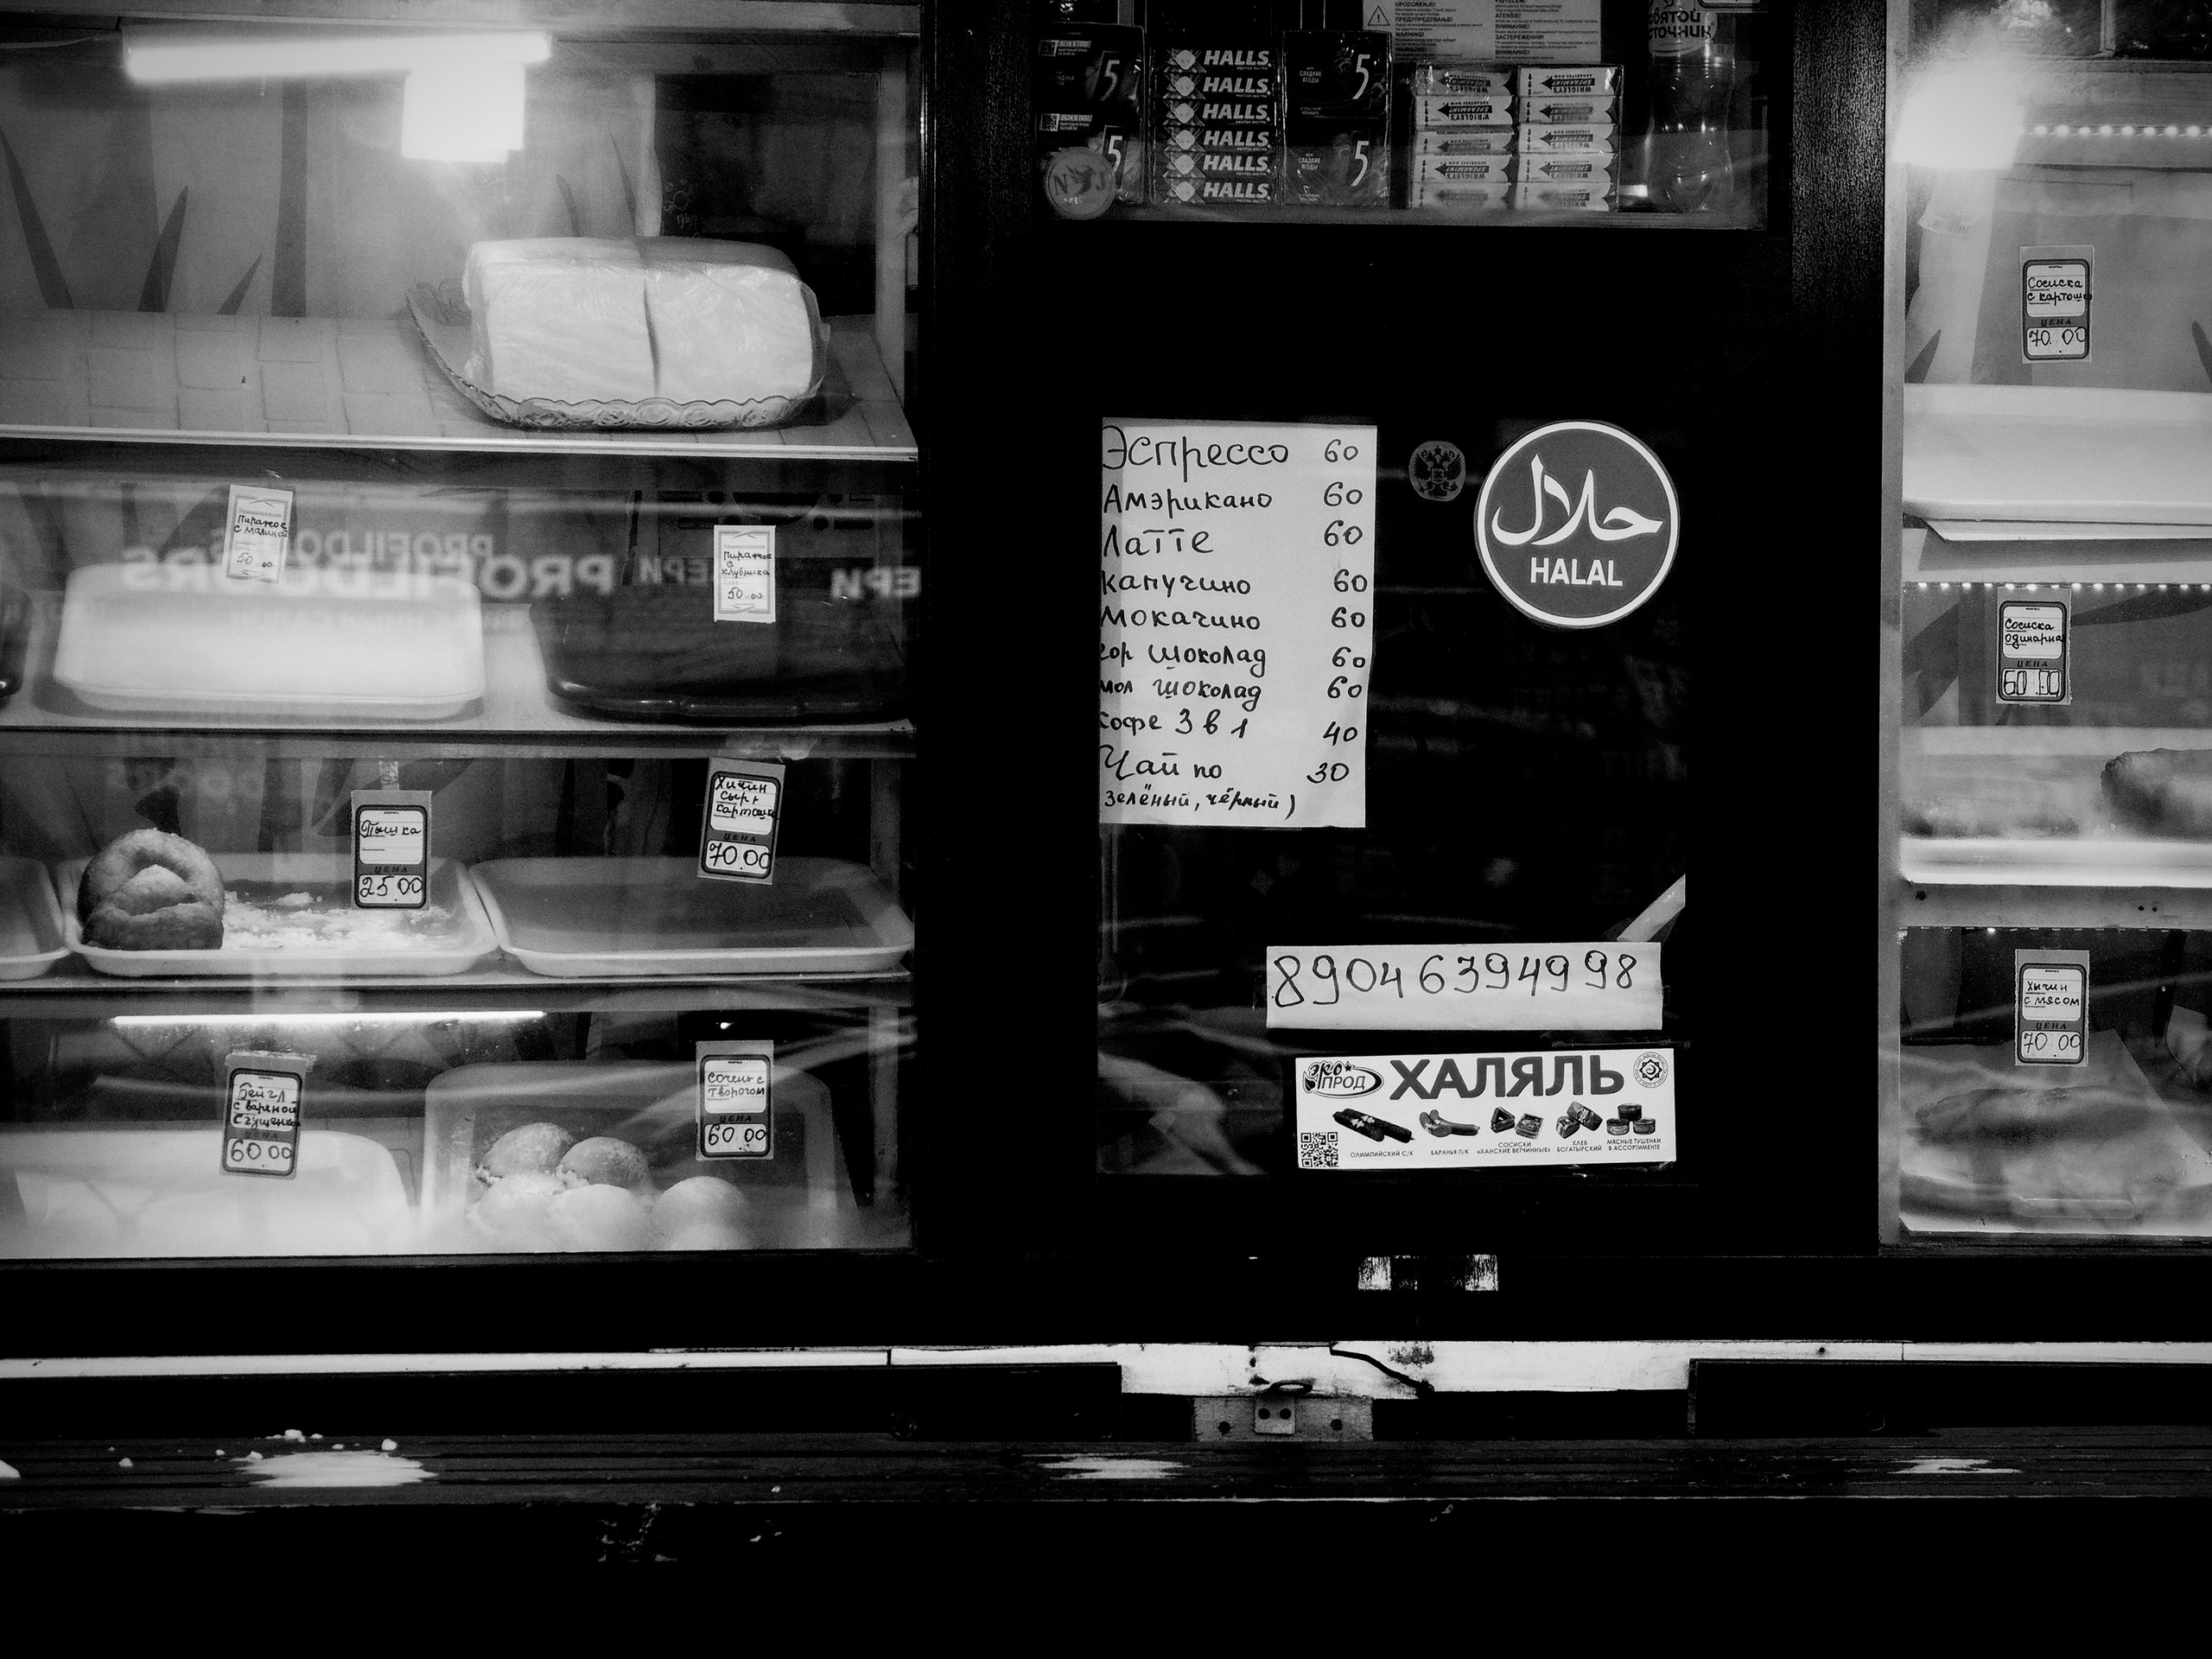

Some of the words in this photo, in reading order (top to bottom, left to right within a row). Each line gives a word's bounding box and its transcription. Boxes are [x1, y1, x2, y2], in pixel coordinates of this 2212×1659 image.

[1204, 50, 1269, 66] HALLS
[1100, 60, 1120, 101] 5
[1203, 77, 1268, 93] HALLS
[1352, 54, 1370, 99] 5
[1202, 104, 1268, 119] HALLS
[1203, 130, 1269, 147] HALLS
[1109, 136, 1122, 173] 5
[1203, 155, 1268, 171] HALLS
[1351, 141, 1370, 187] 5
[1203, 181, 1269, 199] HALLS
[2028, 276, 2082, 289] Сосиска
[2039, 291, 2092, 306] картош
[1103, 425, 1289, 483] Эспрессо
[1324, 439, 1358, 462] 60
[1103, 483, 1272, 518] Амэрикано
[1324, 481, 1363, 506] 60
[1491, 454, 1663, 545] حلال
[1103, 524, 1213, 557] Латте
[1324, 519, 1363, 546] 60
[1334, 569, 1368, 593] 60
[1530, 556, 1624, 587] HALAL
[1332, 607, 1366, 627] 60
[2005, 619, 2055, 631] Сосиска
[2005, 632, 2065, 649] одинарна
[1332, 646, 1365, 668] 60
[1327, 676, 1363, 698] 60
[1175, 708, 1193, 734] 3
[1231, 718, 1248, 739] 1
[1323, 721, 1358, 746] 40
[1100, 744, 1180, 781] Чай
[1306, 762, 1350, 784] 30
[716, 804, 778, 819] картошк
[724, 833, 756, 842] ЦЕНА
[1274, 950, 1637, 1007] 89046394998
[1321, 1076, 1366, 1090] ПРОД
[1389, 1055, 1624, 1100] ХАЛЯЛЬ
